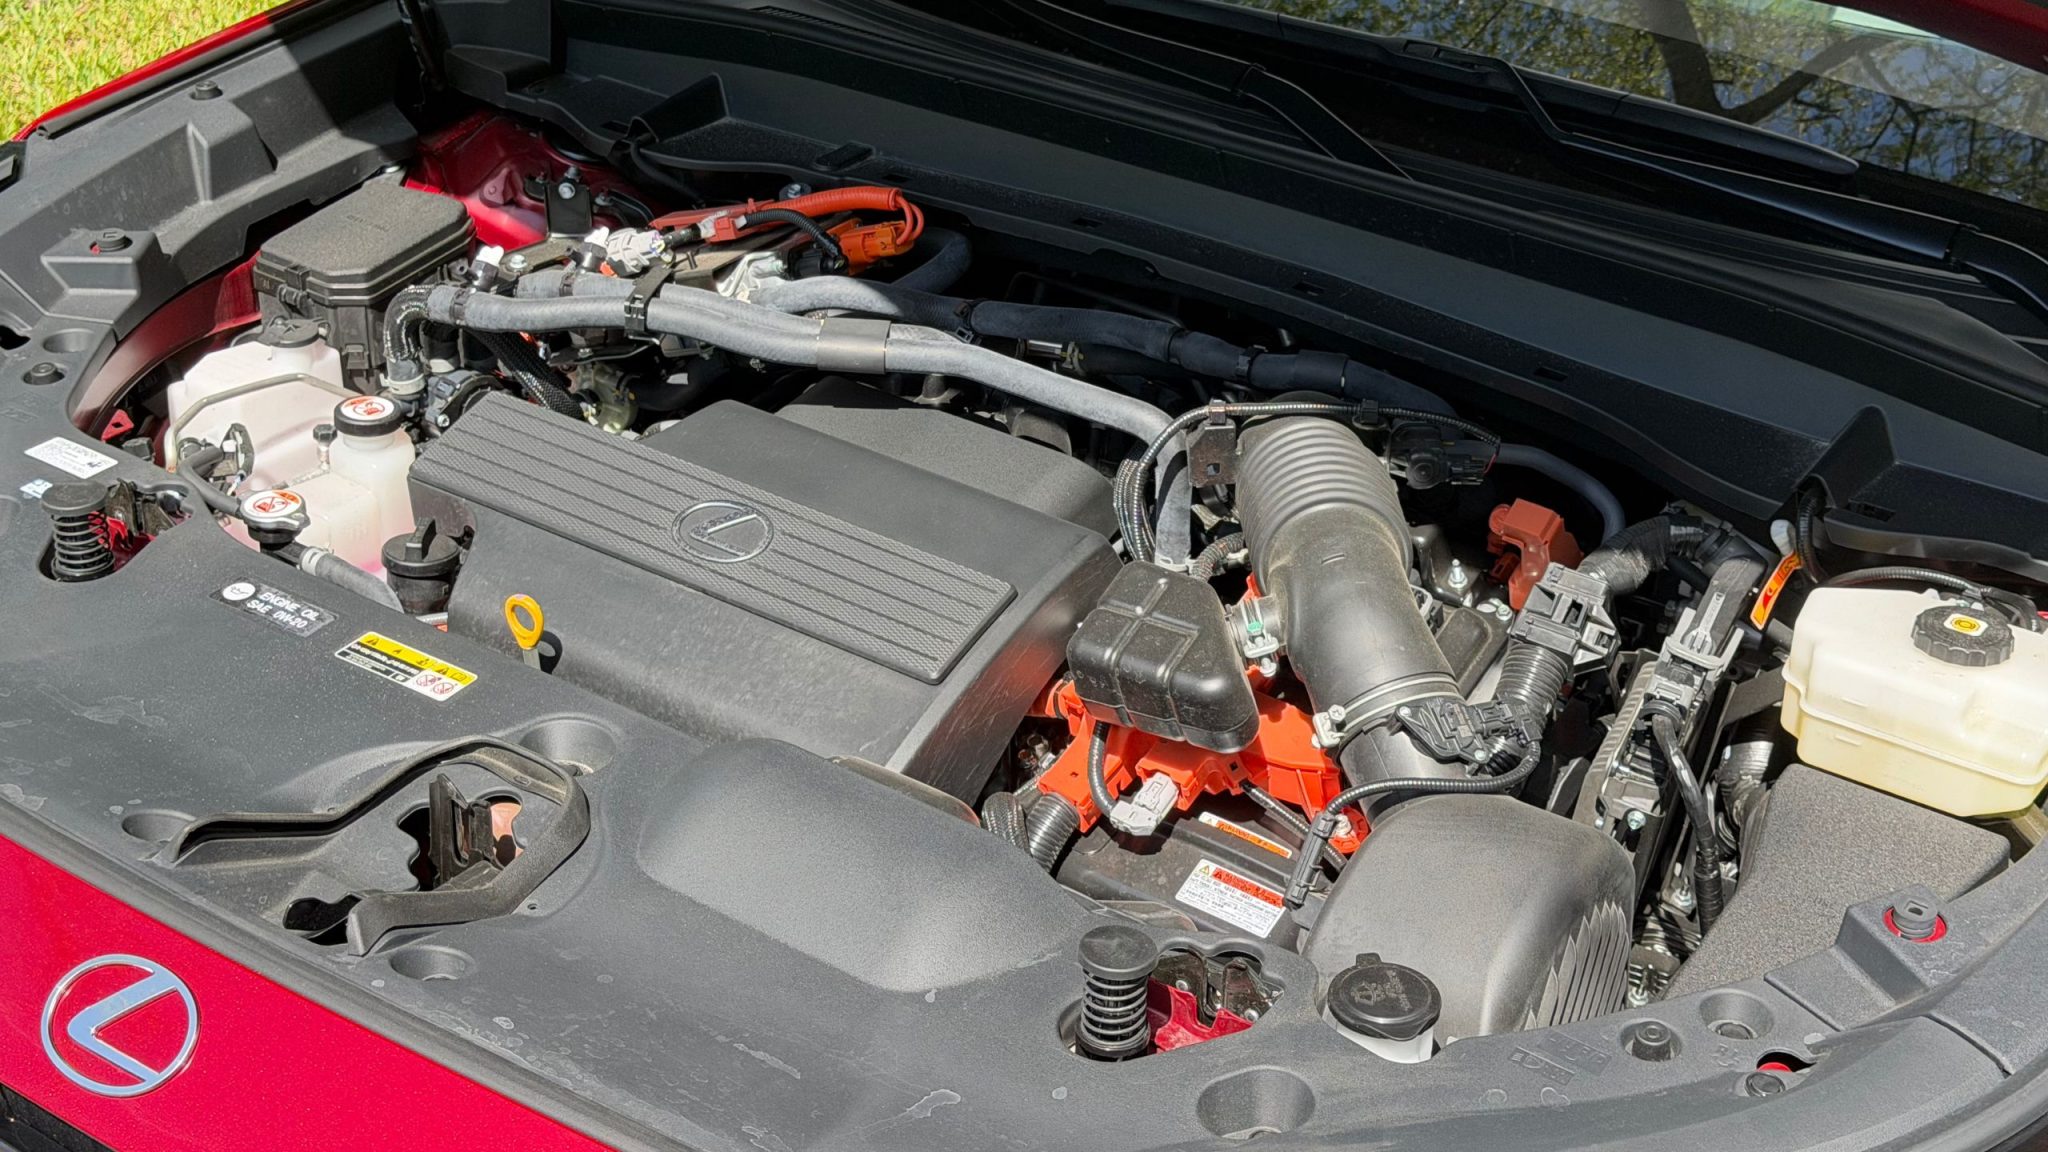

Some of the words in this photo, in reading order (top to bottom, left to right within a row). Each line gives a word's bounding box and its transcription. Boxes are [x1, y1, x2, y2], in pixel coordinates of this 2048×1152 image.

[246, 599, 273, 614] SAE
[273, 610, 308, 629] 0W-20
[258, 592, 301, 612] ENGINE
[301, 609, 320, 621] OIL
